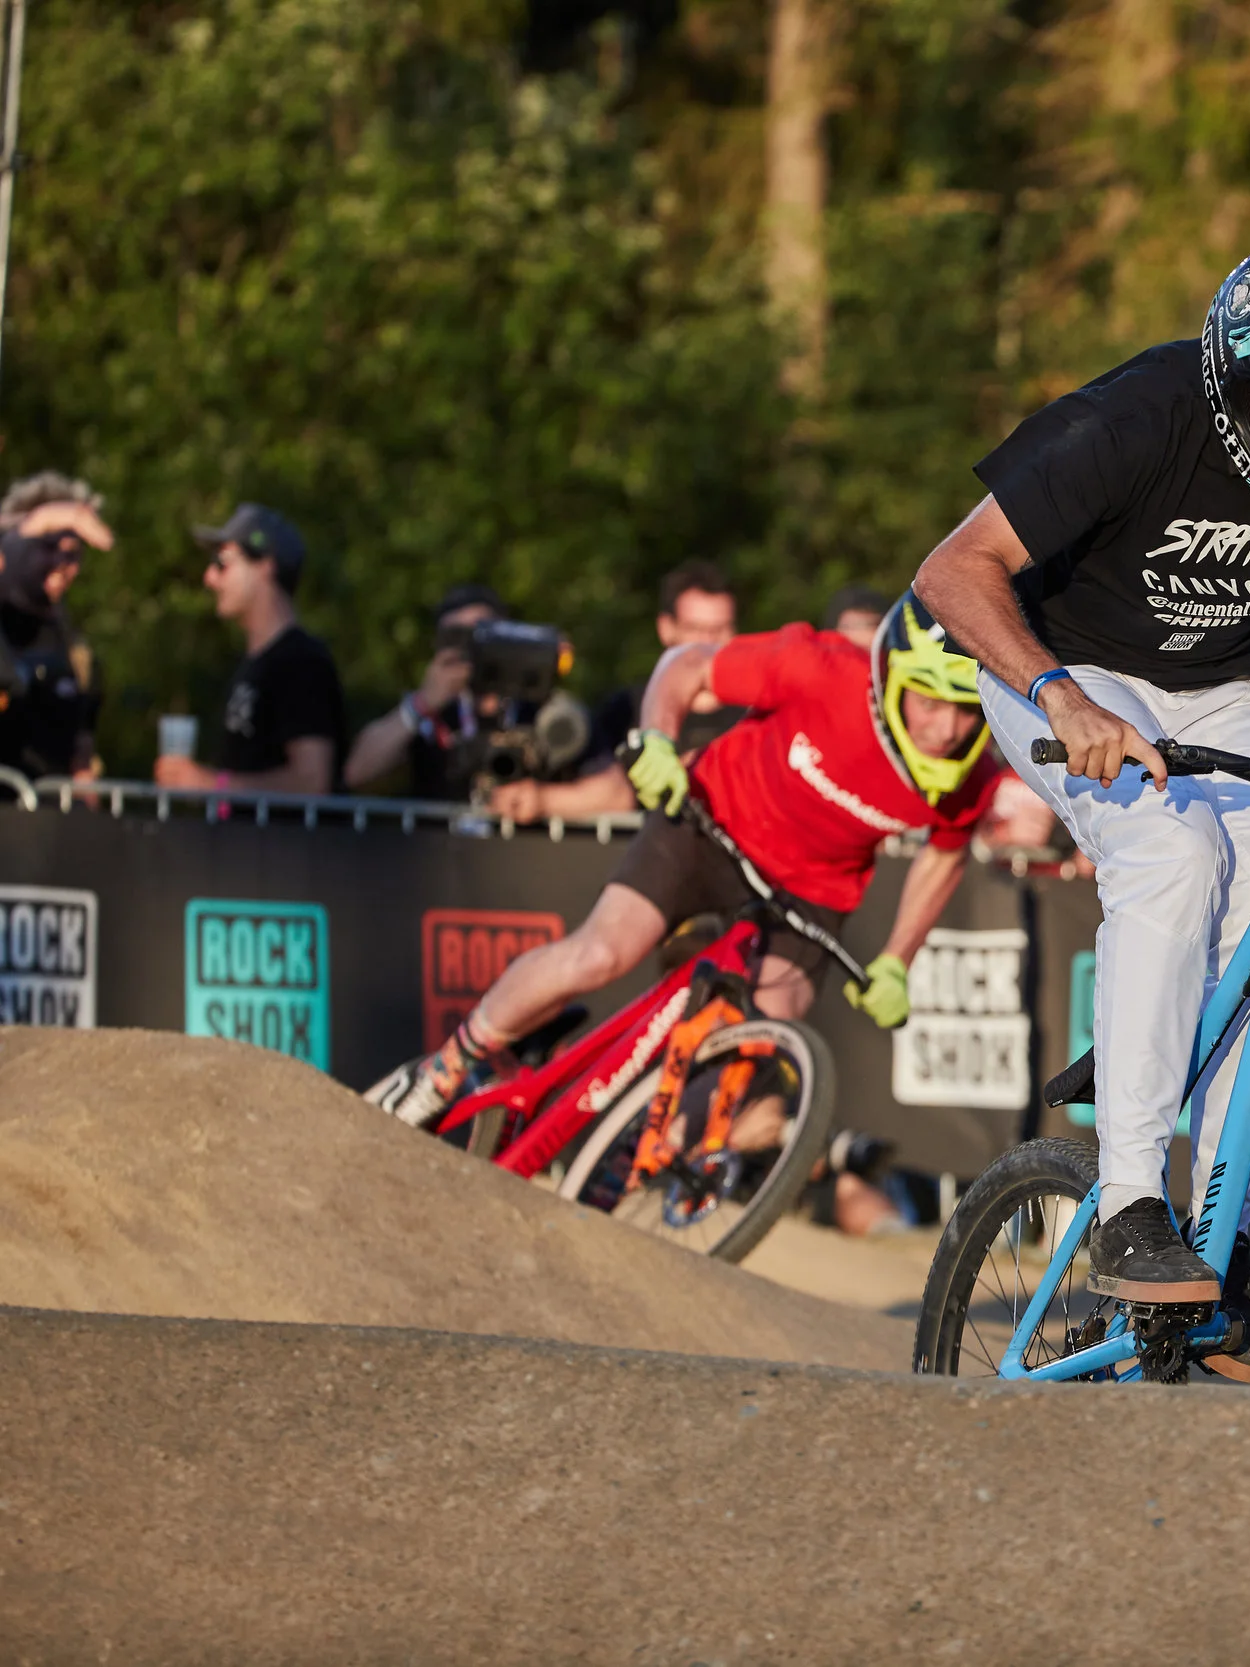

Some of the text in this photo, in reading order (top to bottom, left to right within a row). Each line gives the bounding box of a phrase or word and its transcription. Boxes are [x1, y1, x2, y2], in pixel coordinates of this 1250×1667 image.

[1146, 595, 1250, 617] Continental
[202, 916, 313, 986] ROCK
[439, 928, 549, 993] ROC
[913, 1028, 1015, 1084] SHOX
[1193, 1161, 1228, 1260] ANYON
